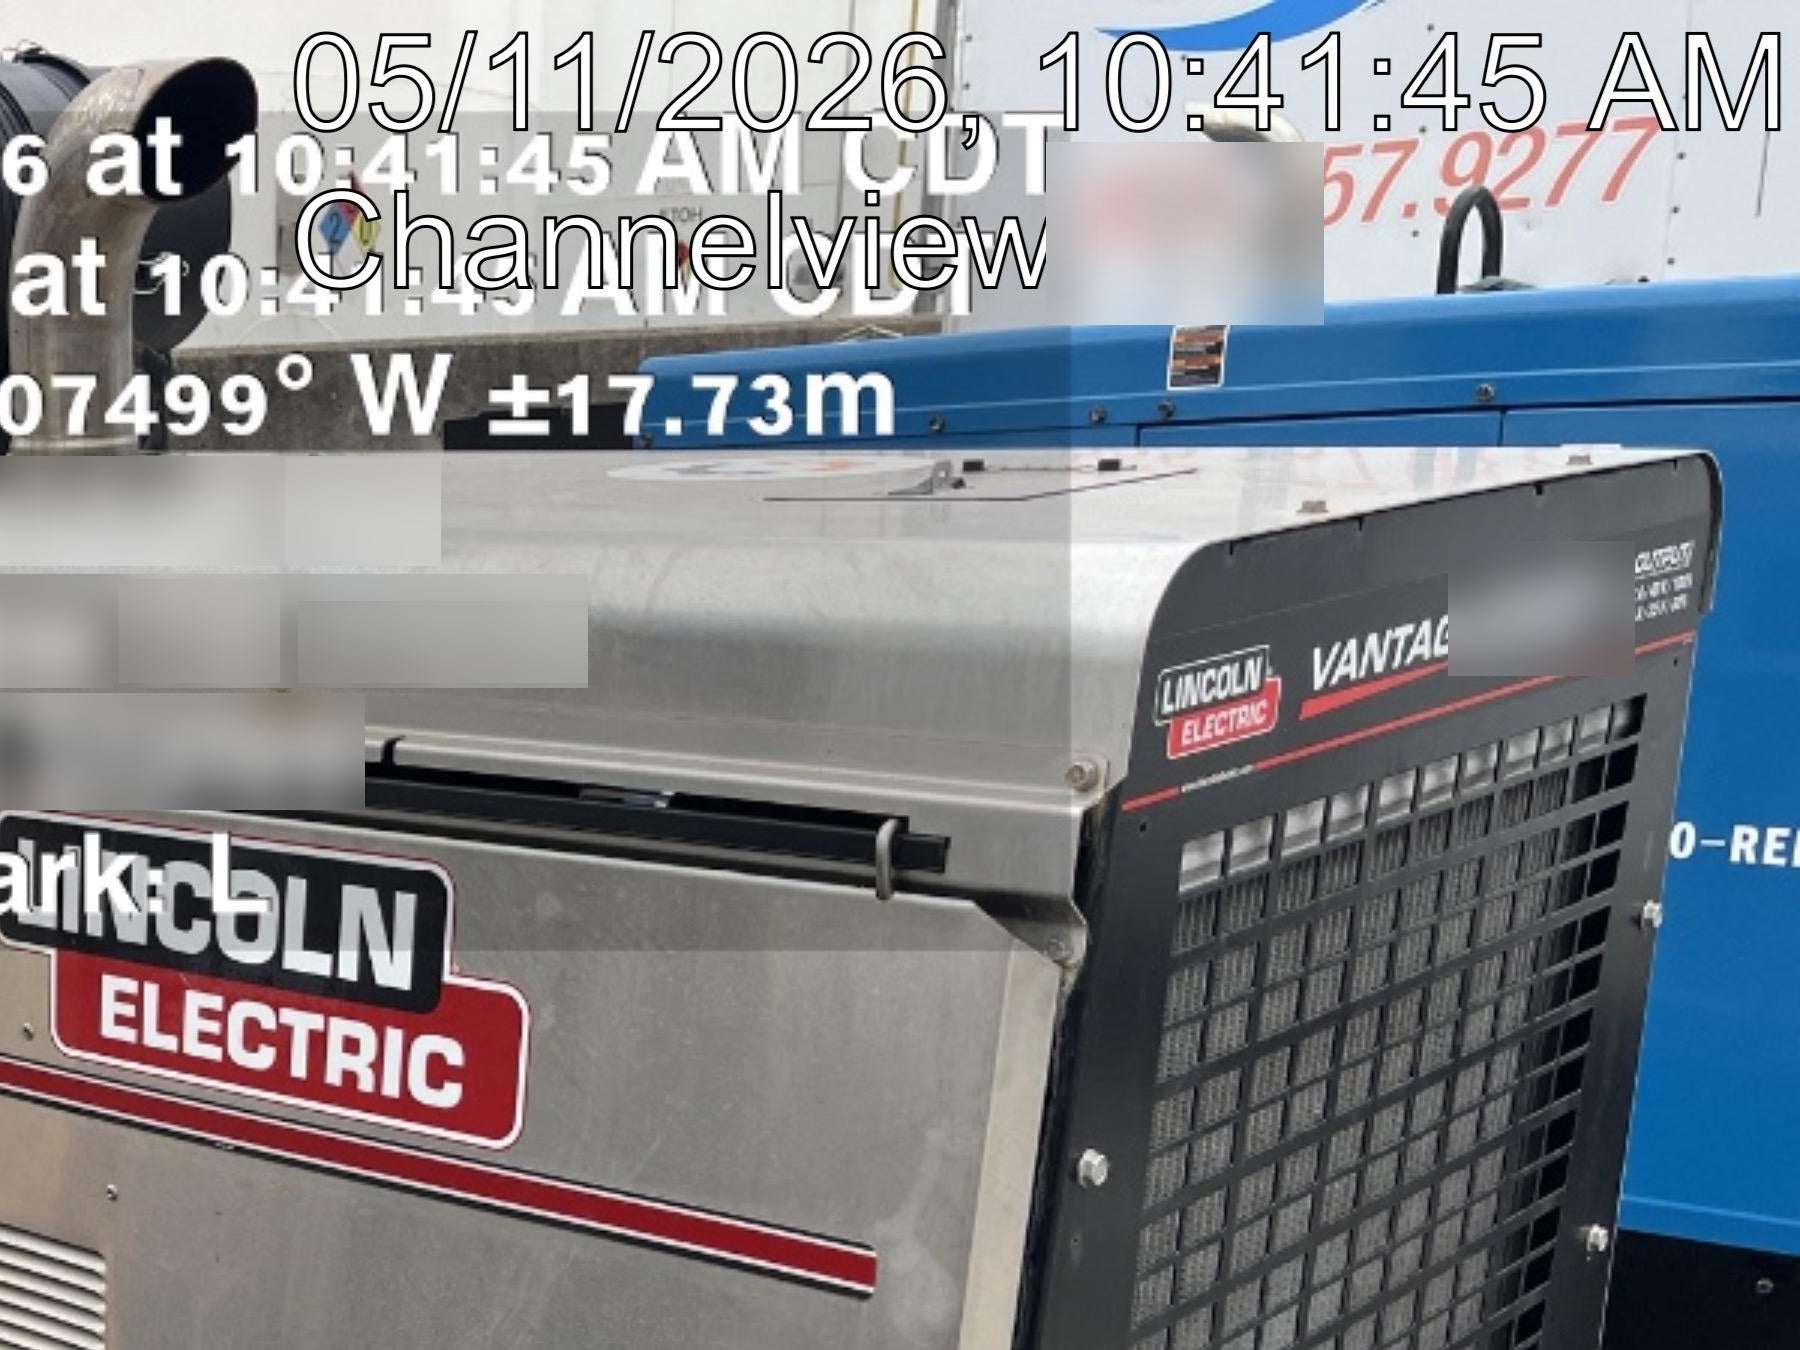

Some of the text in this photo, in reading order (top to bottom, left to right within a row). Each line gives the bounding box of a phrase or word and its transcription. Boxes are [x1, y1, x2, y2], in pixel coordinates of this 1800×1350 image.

[1161, 655, 1263, 715] LINCOLN
[1312, 614, 1449, 691] VANTAG
[1181, 698, 1268, 747] ELECTRIC
[99, 973, 466, 1109] ELECTRIC
